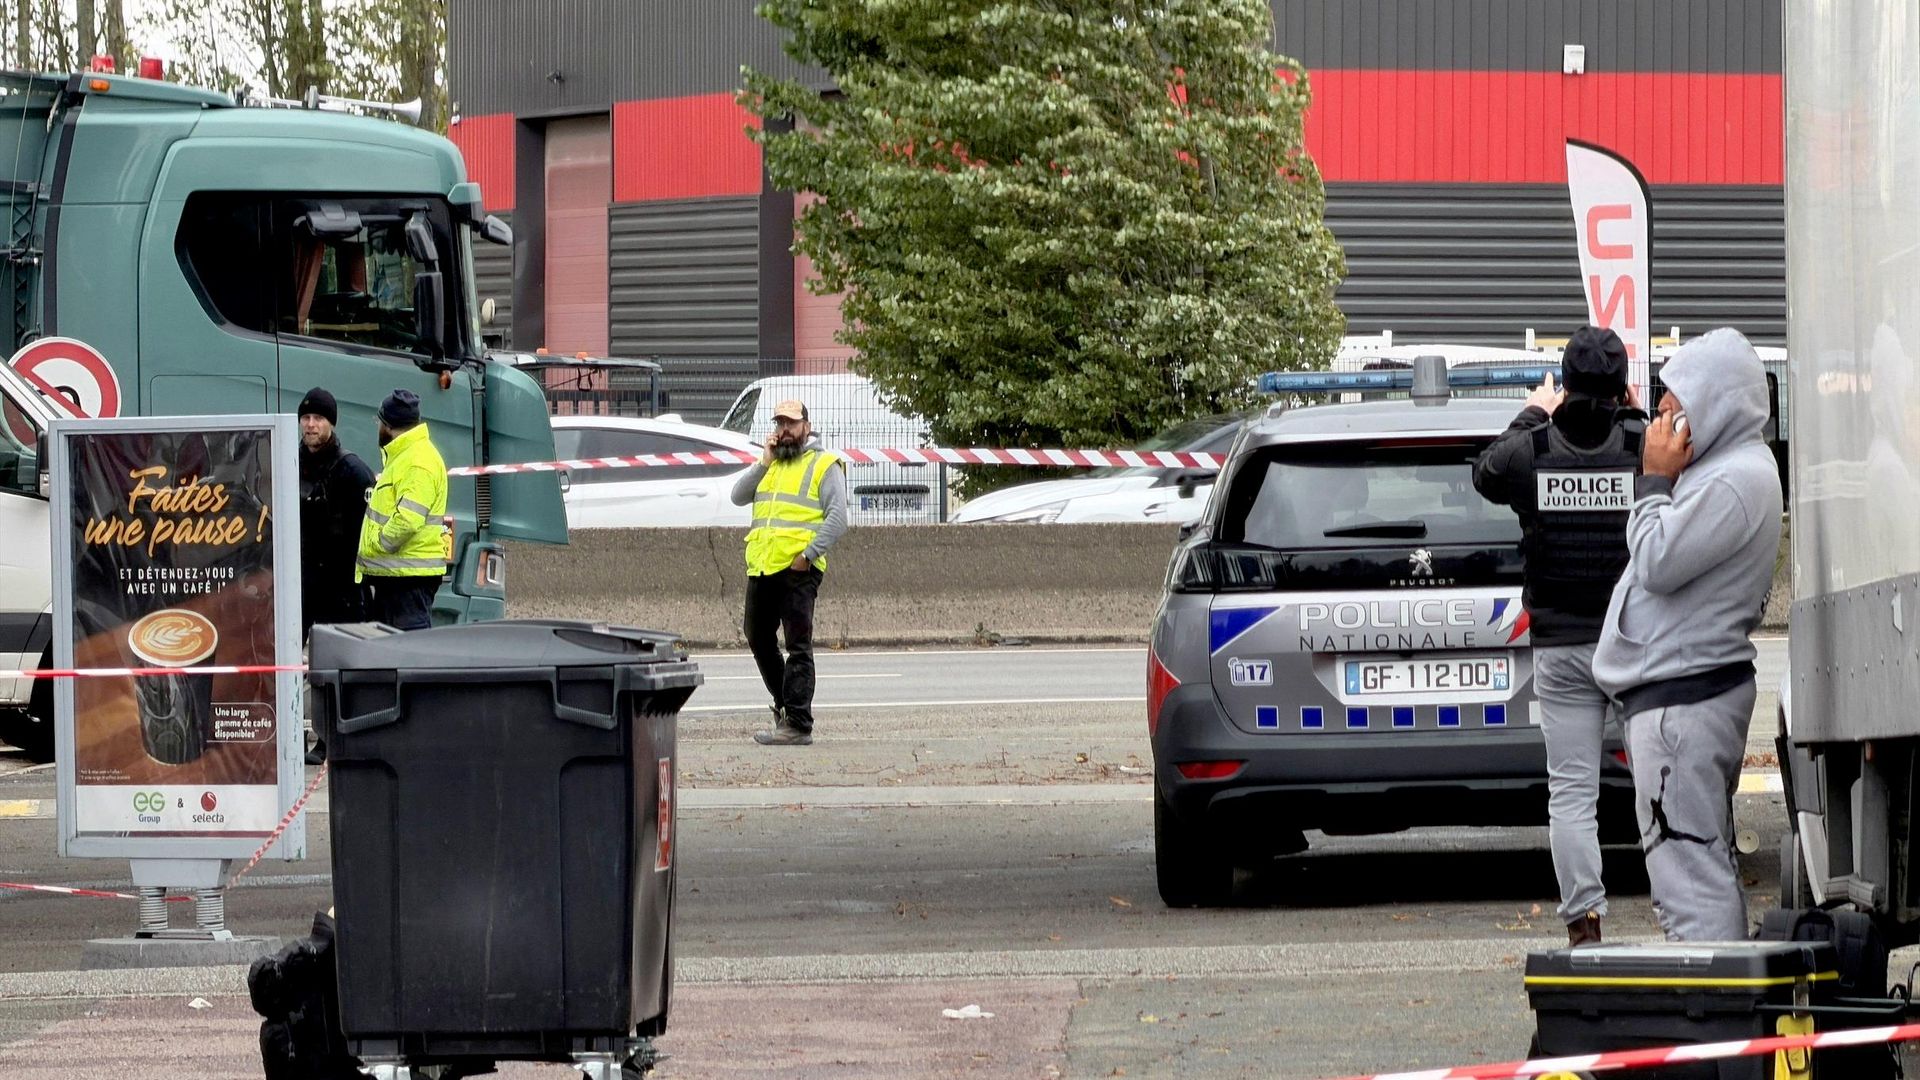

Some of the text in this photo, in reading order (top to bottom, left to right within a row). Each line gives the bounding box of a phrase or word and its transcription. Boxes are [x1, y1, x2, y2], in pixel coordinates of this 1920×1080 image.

[129, 466, 229, 514] Faites
[1547, 477, 1623, 494] POLICE
[1544, 495, 1628, 507] JUDICIAIRE
[85, 504, 268, 557] une pause !
[120, 566, 234, 580] ET DÉTENDEZ-VOUS
[127, 582, 155, 594] AVEC
[162, 582, 177, 594] UN
[183, 580, 211, 594] CAFÉ
[1390, 578, 1455, 586] PEUGEOT
[1299, 599, 1475, 631] POLICE
[1300, 631, 1476, 650] NATIONALE
[1246, 664, 1268, 681] 17
[1495, 674, 1507, 686] 78
[214, 707, 249, 719] Une large
[214, 717, 272, 730] gamme de cafés
[177, 797, 184, 808] &
[138, 813, 161, 824] Group
[192, 813, 225, 823] selecta
